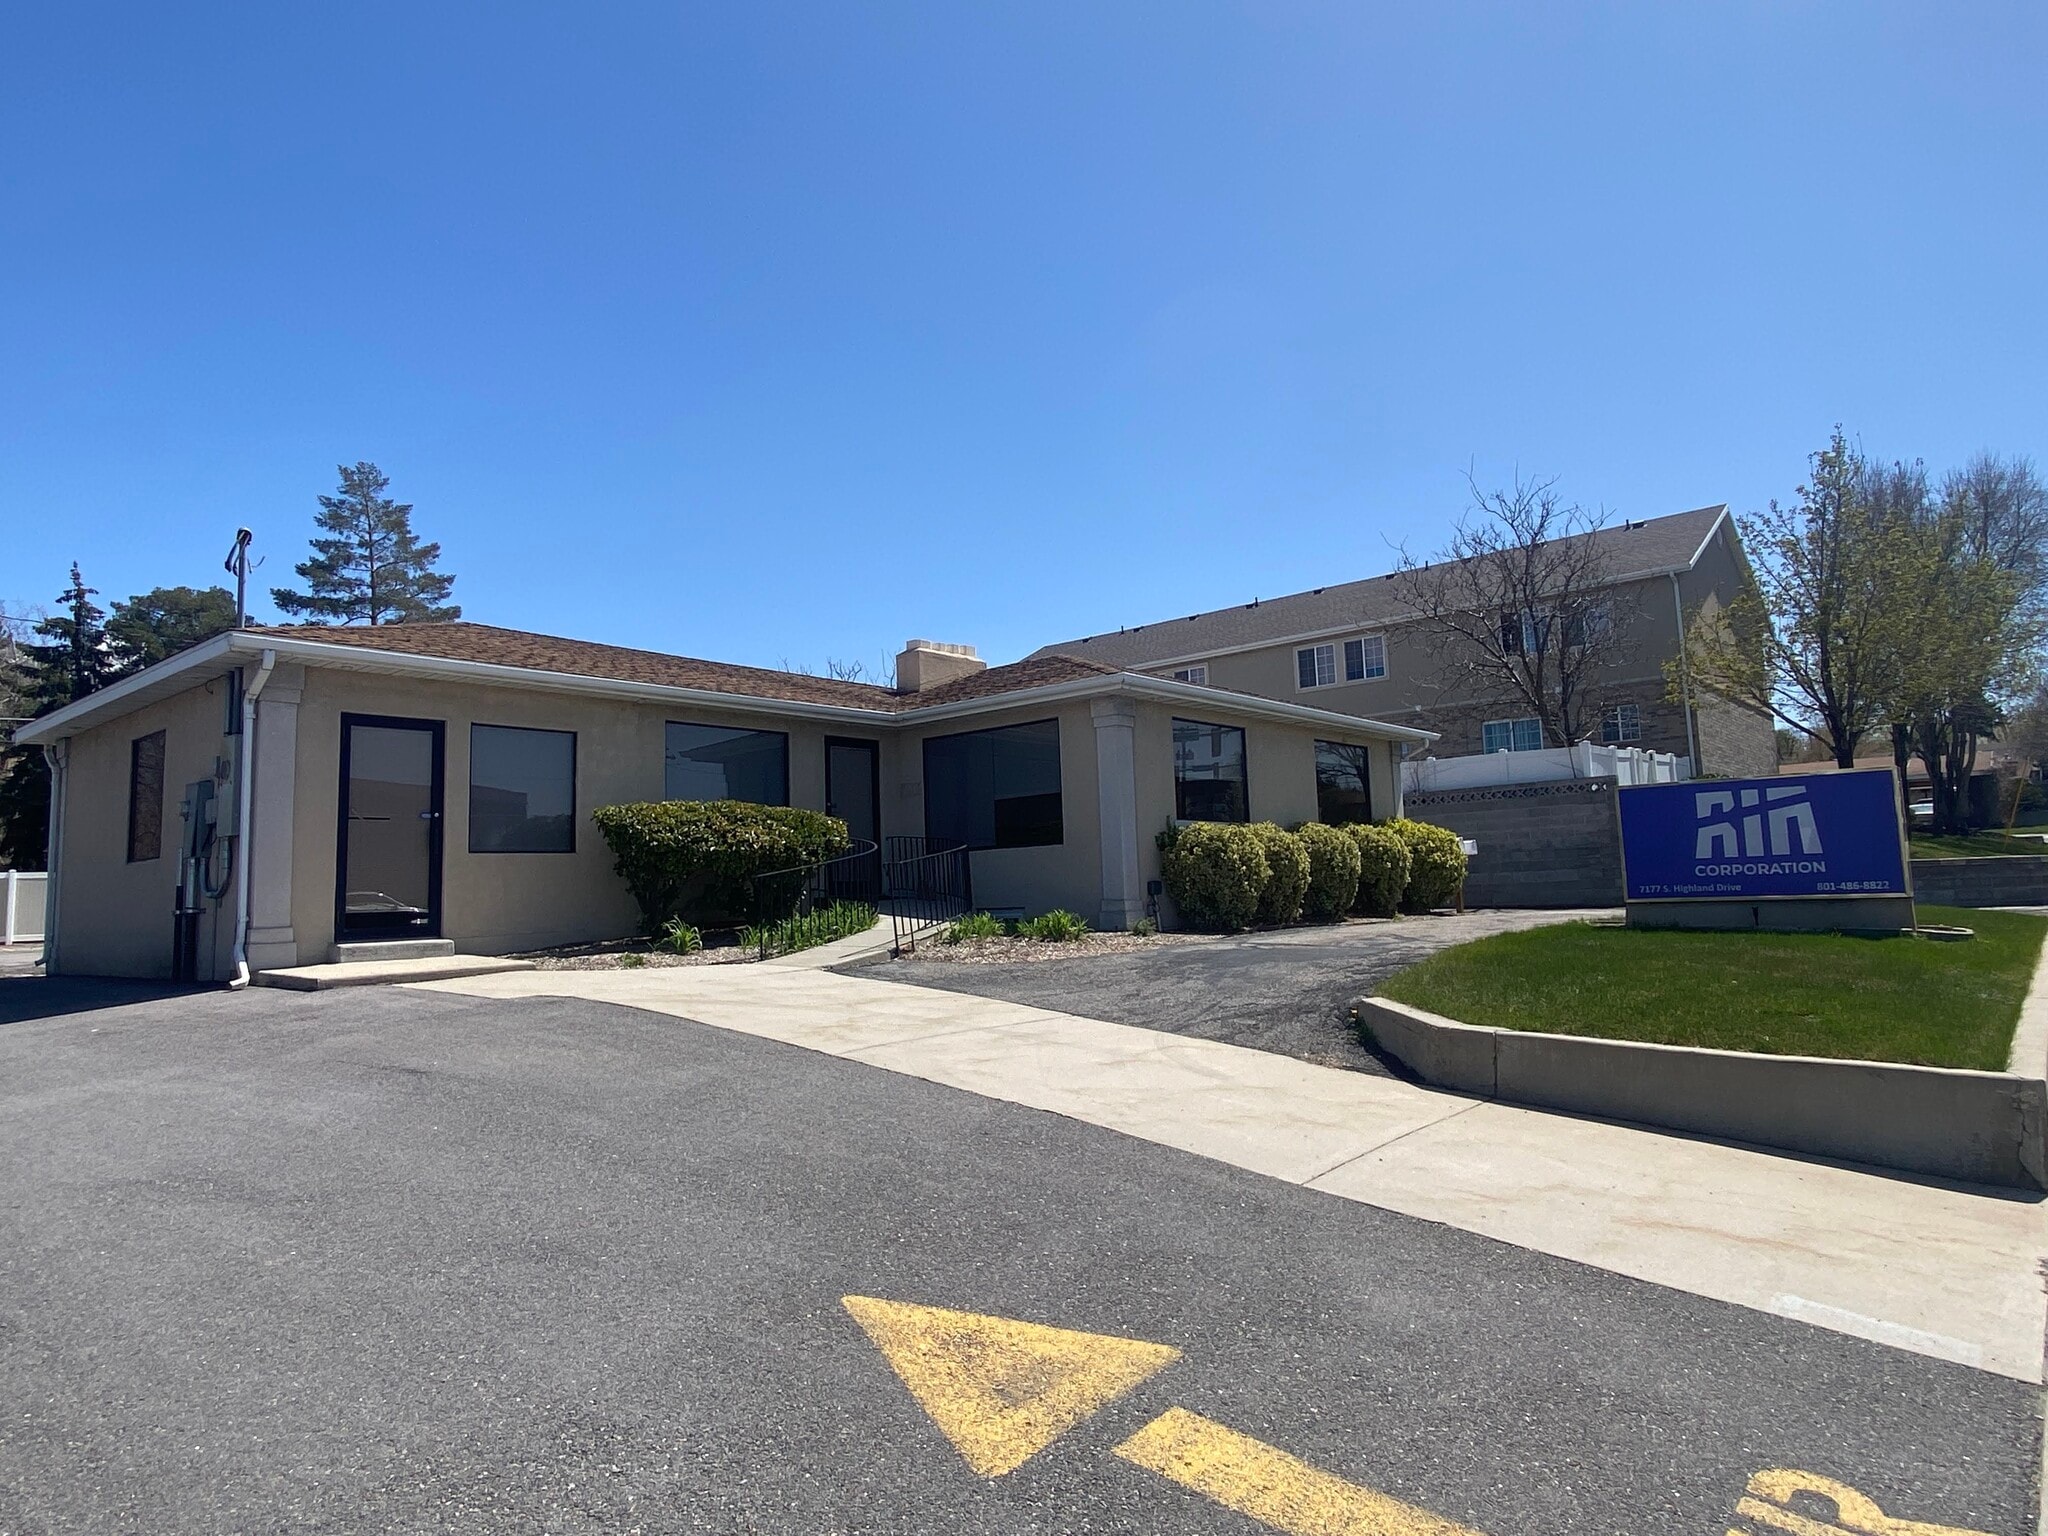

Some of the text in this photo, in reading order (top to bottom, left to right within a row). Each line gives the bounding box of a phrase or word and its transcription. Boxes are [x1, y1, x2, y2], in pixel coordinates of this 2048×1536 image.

[1695, 861, 1826, 877] CORPORATION
[1639, 885, 1660, 893] 7177
[1674, 883, 1714, 894] Highland
[1716, 883, 1742, 892] Drive
[1817, 881, 1890, 891] 801-486-8822
